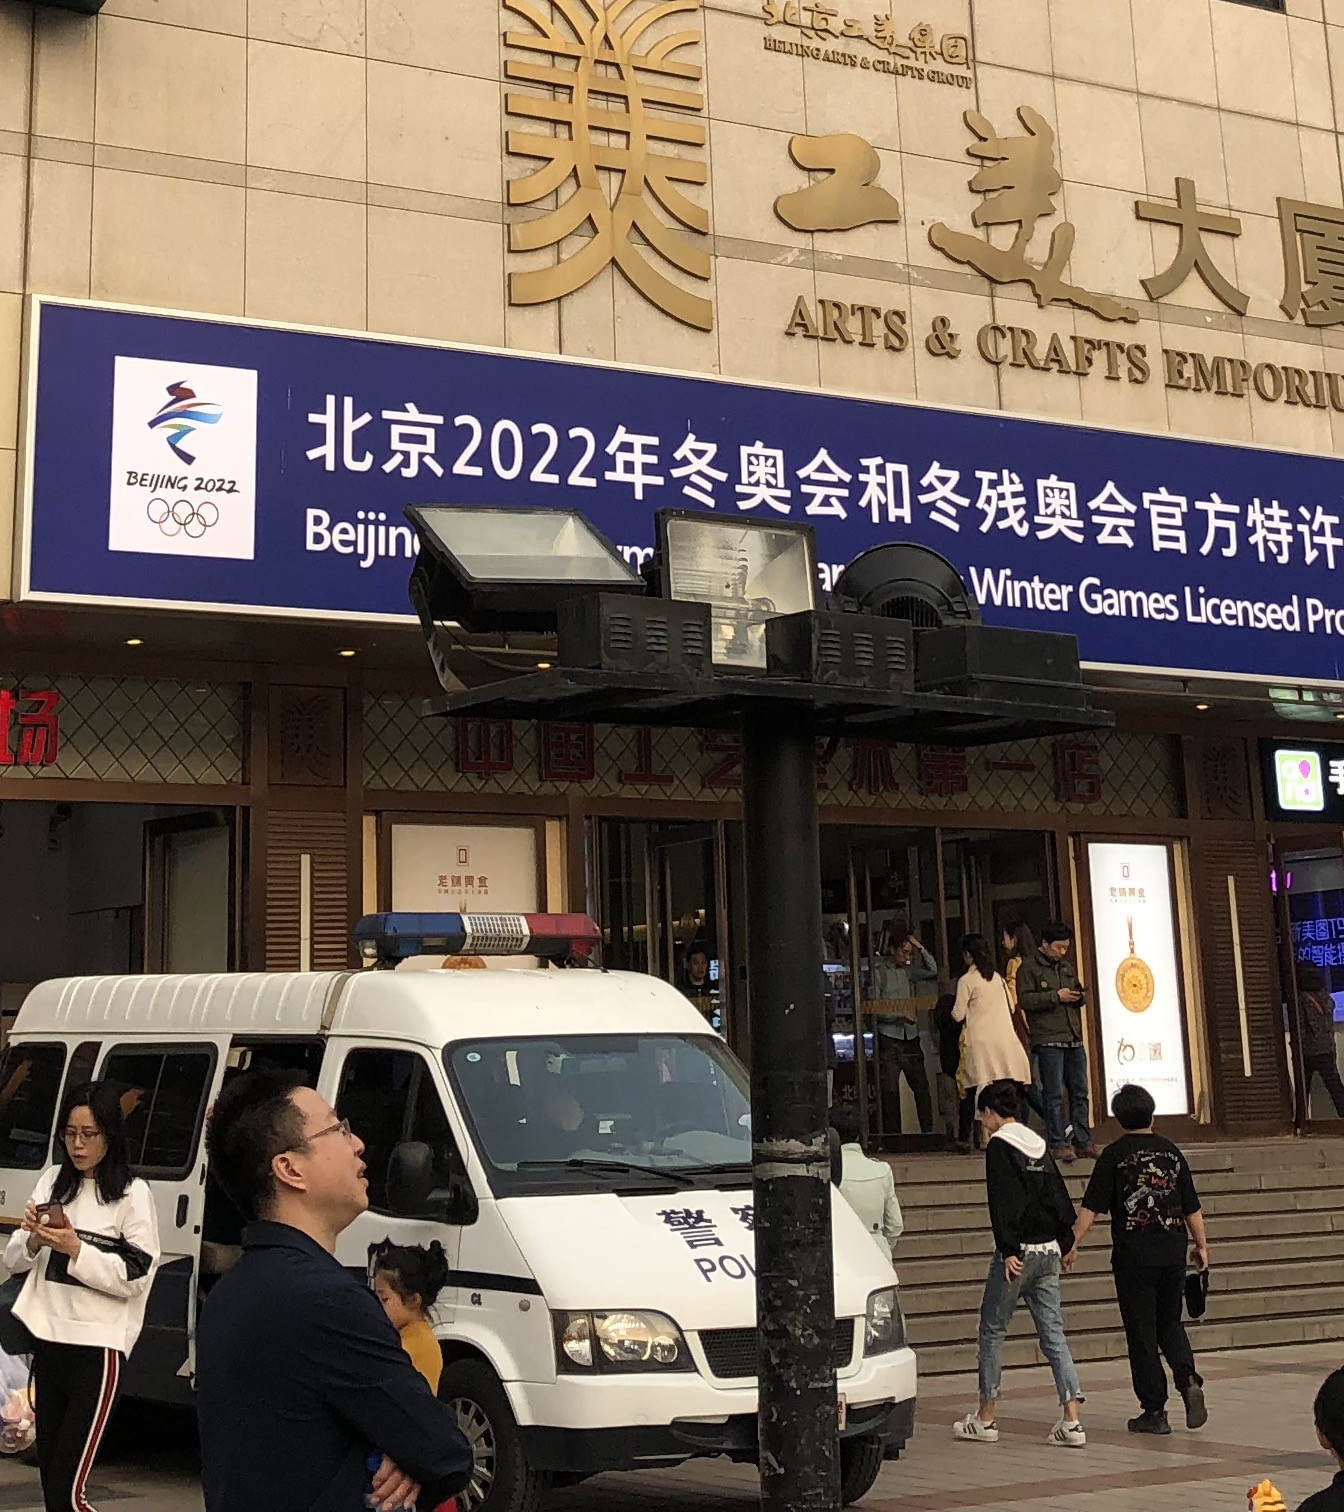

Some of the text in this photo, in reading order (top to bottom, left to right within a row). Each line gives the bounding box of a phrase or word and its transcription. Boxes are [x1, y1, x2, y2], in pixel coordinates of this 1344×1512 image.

[763, 35, 974, 89] BEIJING ARTS & CRAFTS GROUP
[785, 295, 910, 351] ARTS
[926, 315, 962, 359] &
[976, 324, 1151, 384] CRAFTS
[126, 471, 242, 494] BEIJING 2022
[969, 566, 1073, 612] Winter
[1079, 576, 1180, 622] Games
[1185, 586, 1301, 632] Licensed
[459, 717, 1103, 804] 中国工艺术第一店
